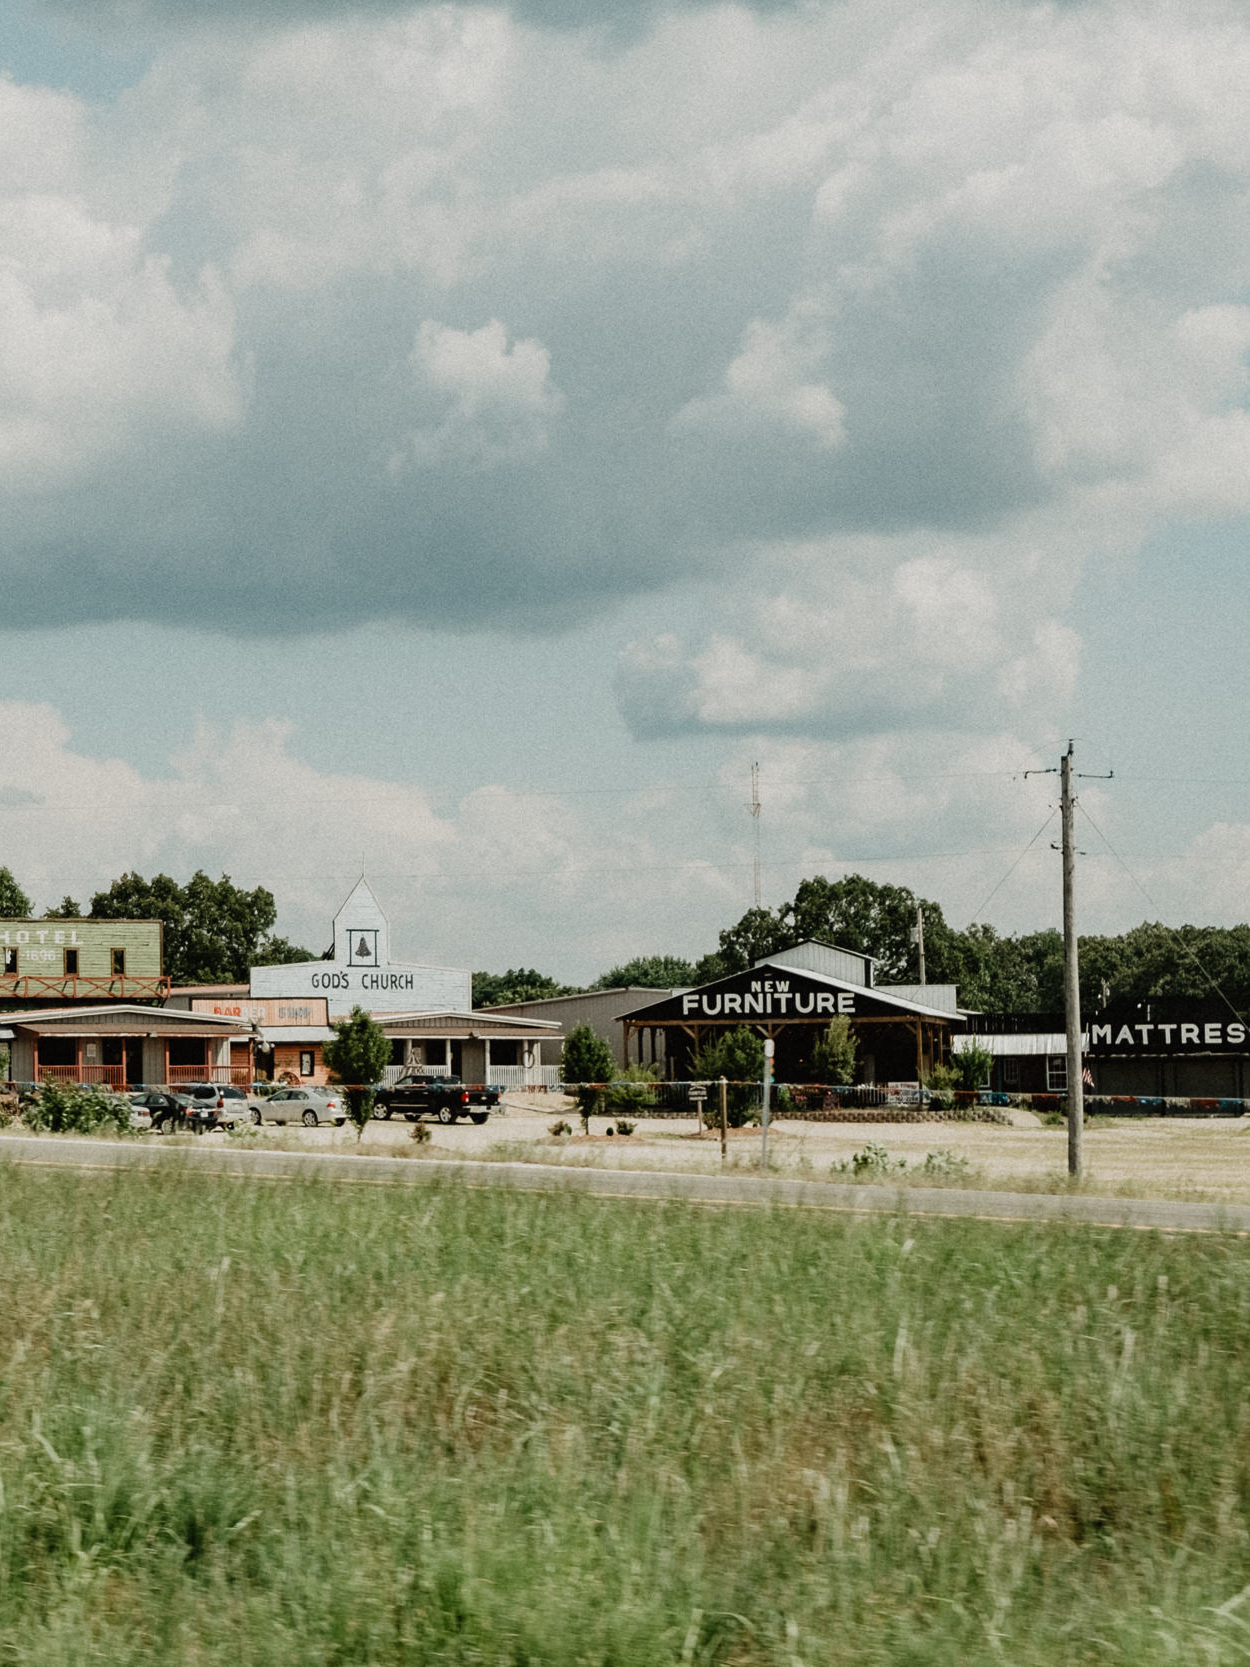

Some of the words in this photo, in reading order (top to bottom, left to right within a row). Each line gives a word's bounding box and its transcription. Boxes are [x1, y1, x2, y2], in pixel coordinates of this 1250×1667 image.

[311, 971, 350, 989] GOD'S
[361, 973, 414, 990] CHURCH
[751, 980, 790, 993] NEW
[682, 992, 856, 1016] FURNITURE
[1091, 1022, 1246, 1046] MATTRES
